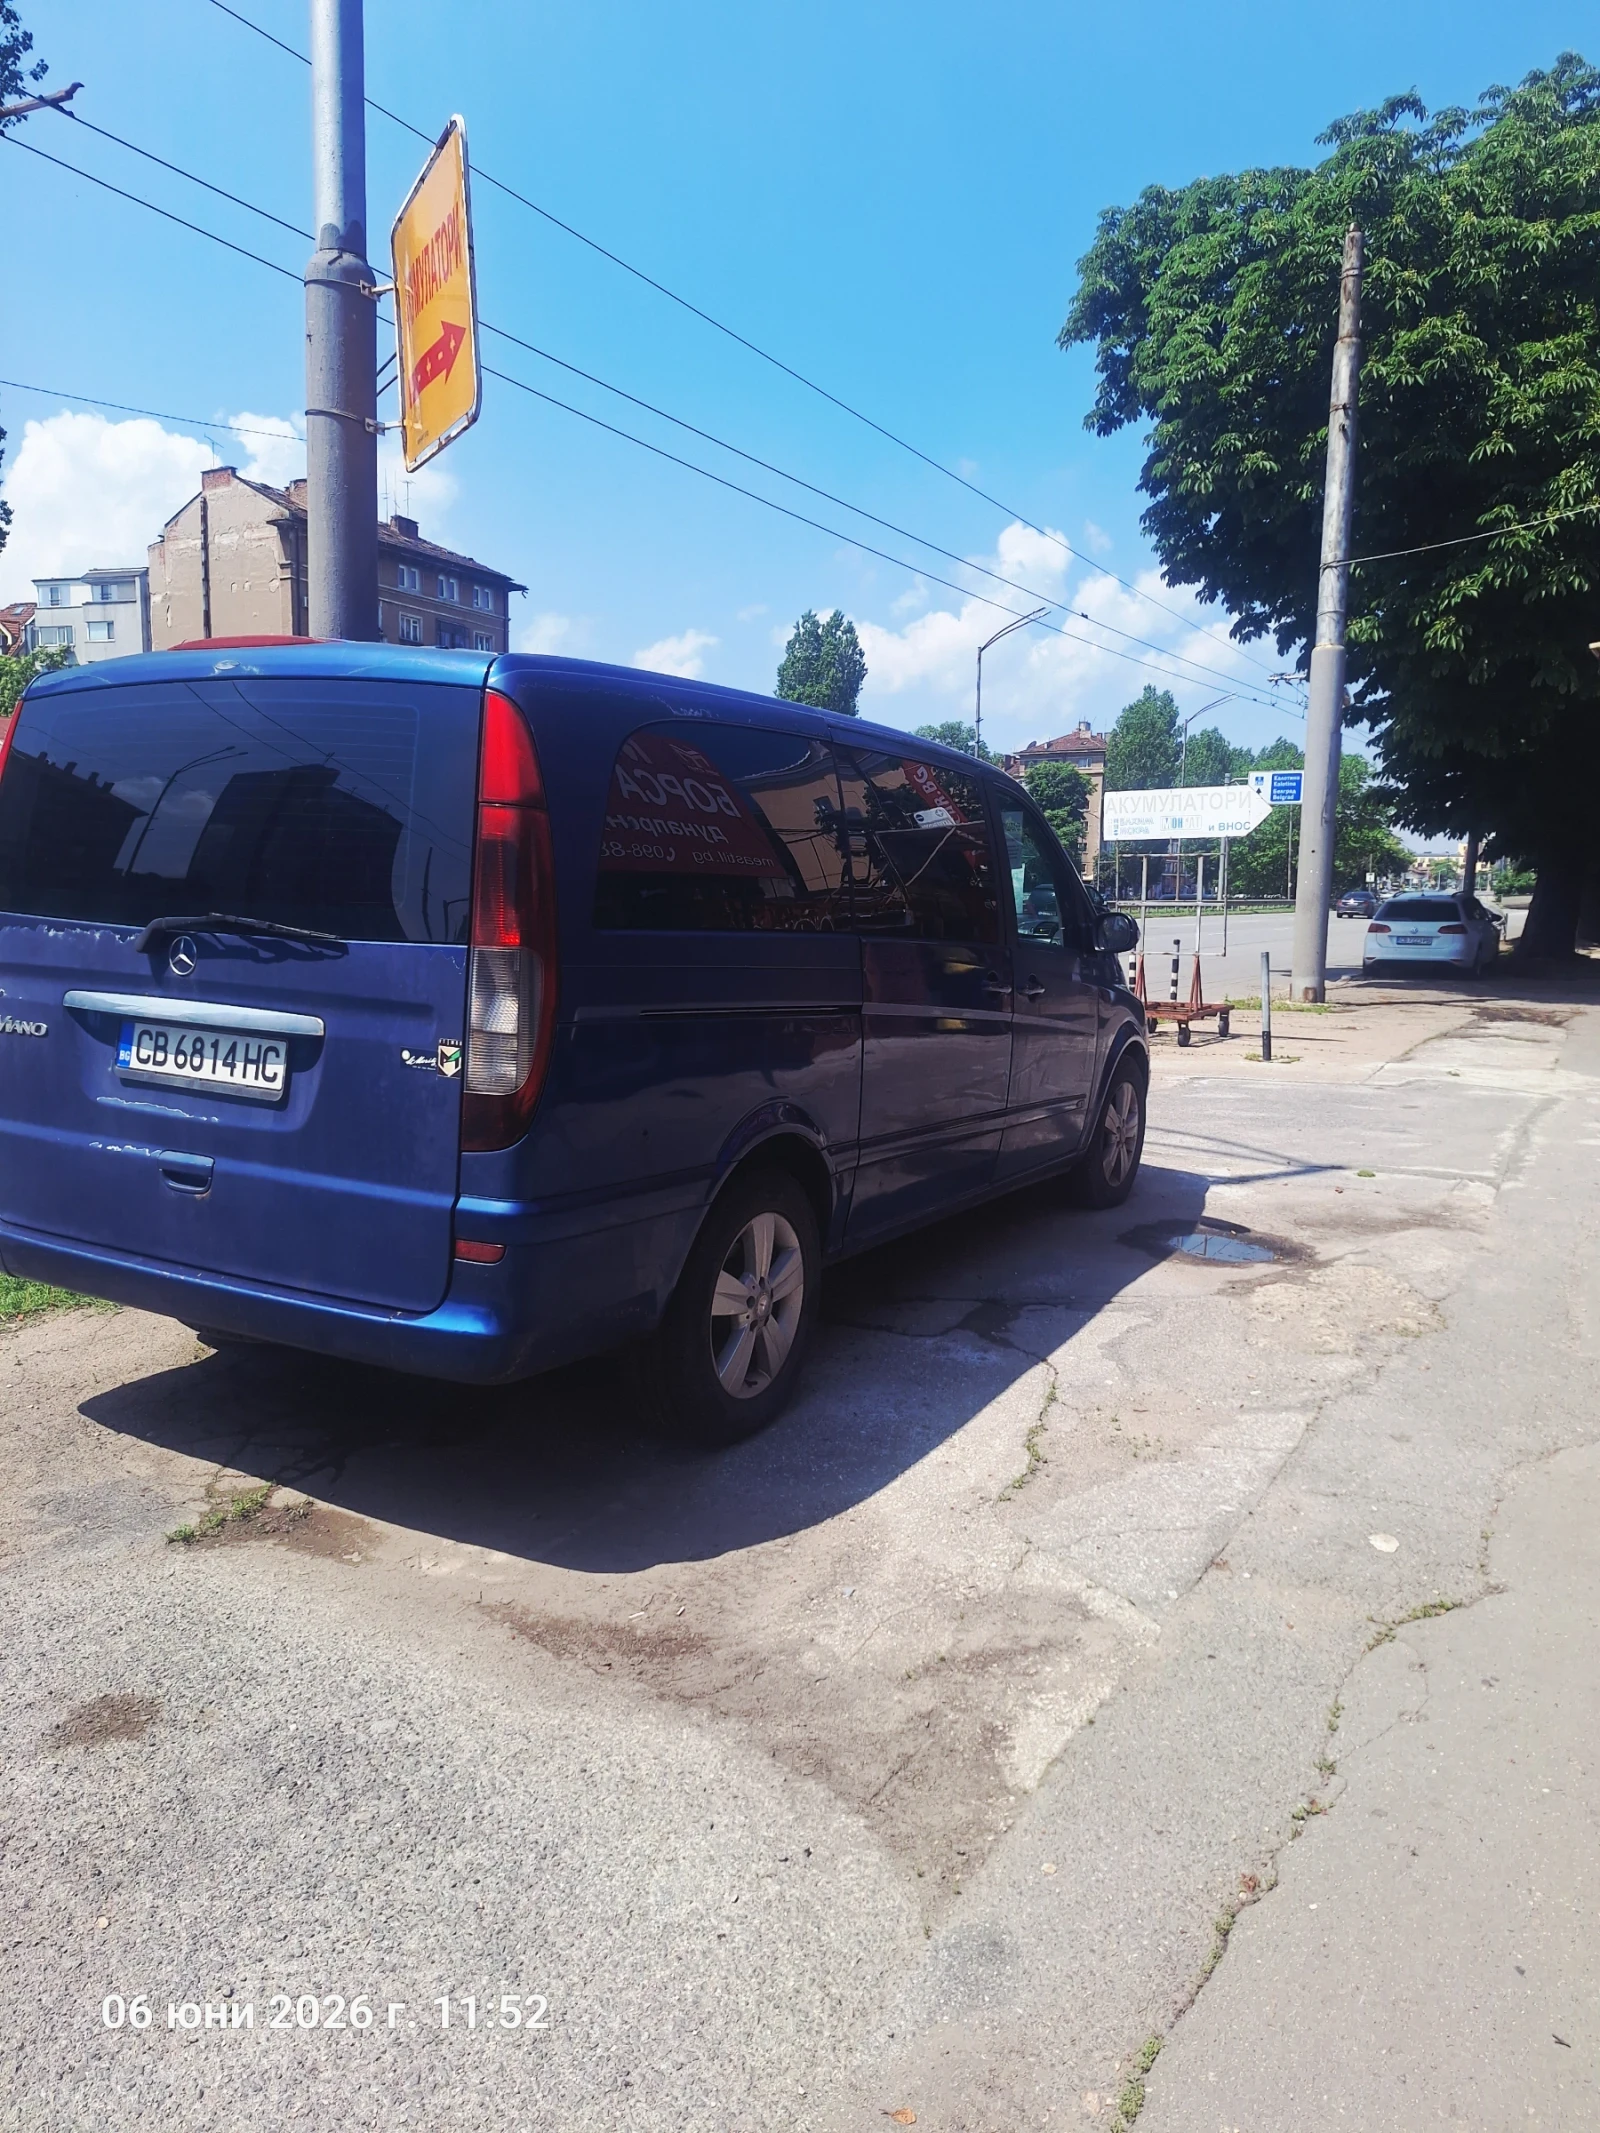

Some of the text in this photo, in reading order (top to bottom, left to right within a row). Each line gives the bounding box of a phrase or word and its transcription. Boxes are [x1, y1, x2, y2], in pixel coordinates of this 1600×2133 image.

[1105, 791, 1252, 814] АКУМУЛАТОРИ
[1218, 822, 1251, 832] ВНОС
[119, 1050, 131, 1061] BG
